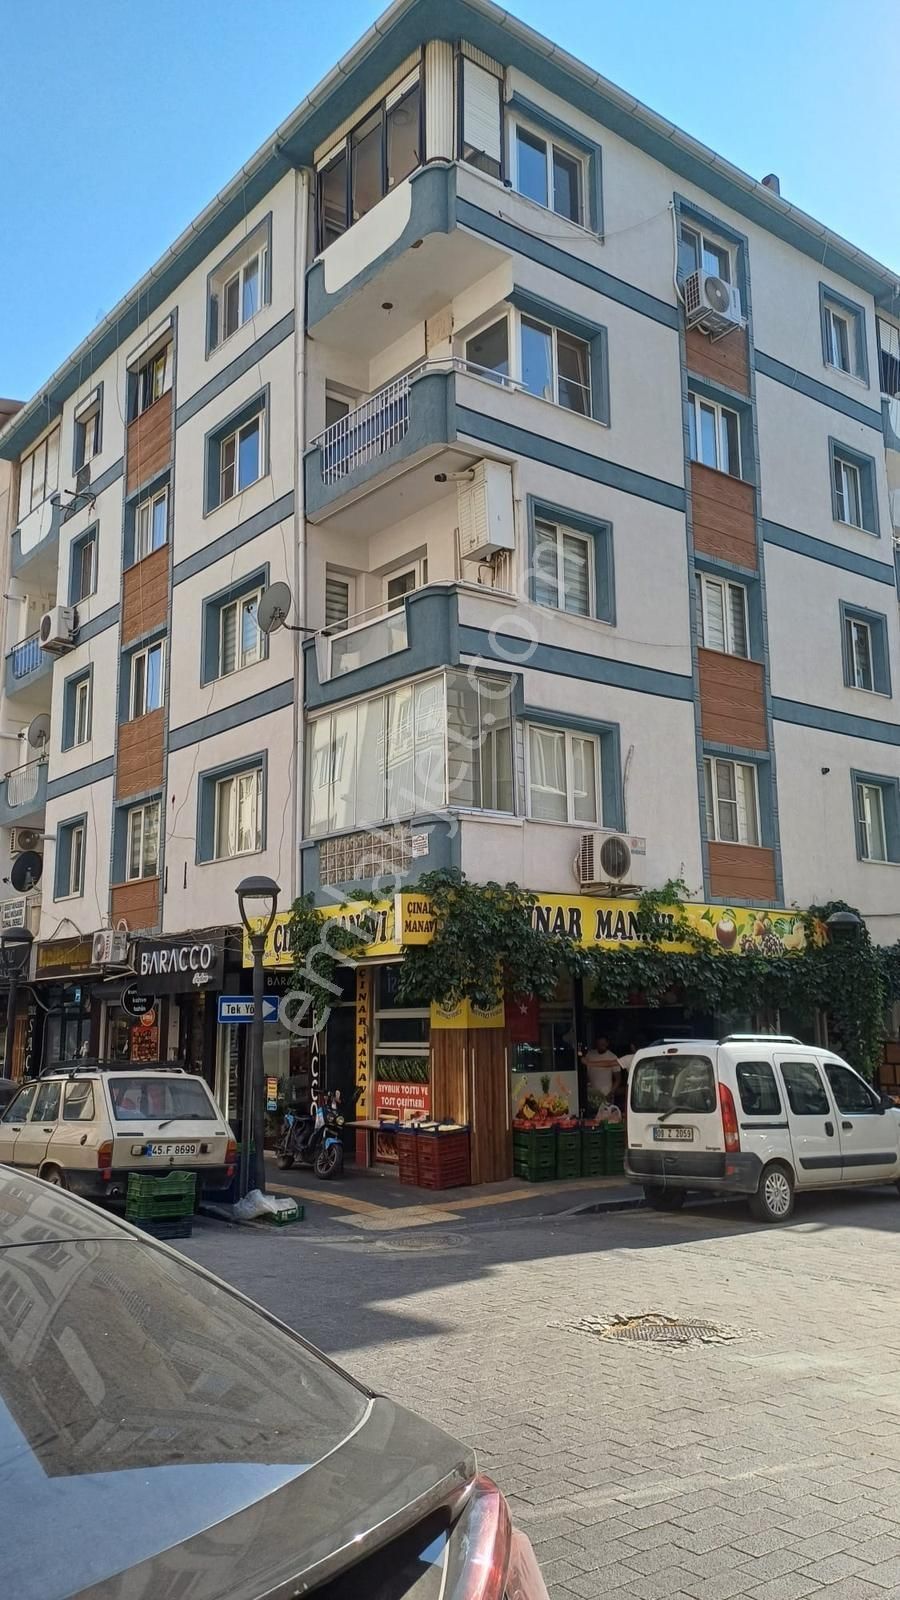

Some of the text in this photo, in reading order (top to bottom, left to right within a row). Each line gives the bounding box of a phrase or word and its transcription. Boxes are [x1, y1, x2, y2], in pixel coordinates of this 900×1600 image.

[140, 944, 211, 976] BARACCO
[226, 1003, 255, 1014] Tek Yö
[401, 1085, 420, 1096] TOSTU
[420, 1086, 429, 1096] VE
[381, 1096, 396, 1106] TOST
[668, 1128, 672, 1138] Z
[675, 1128, 691, 1138] 2059
[174, 1145, 196, 1154] 8699
